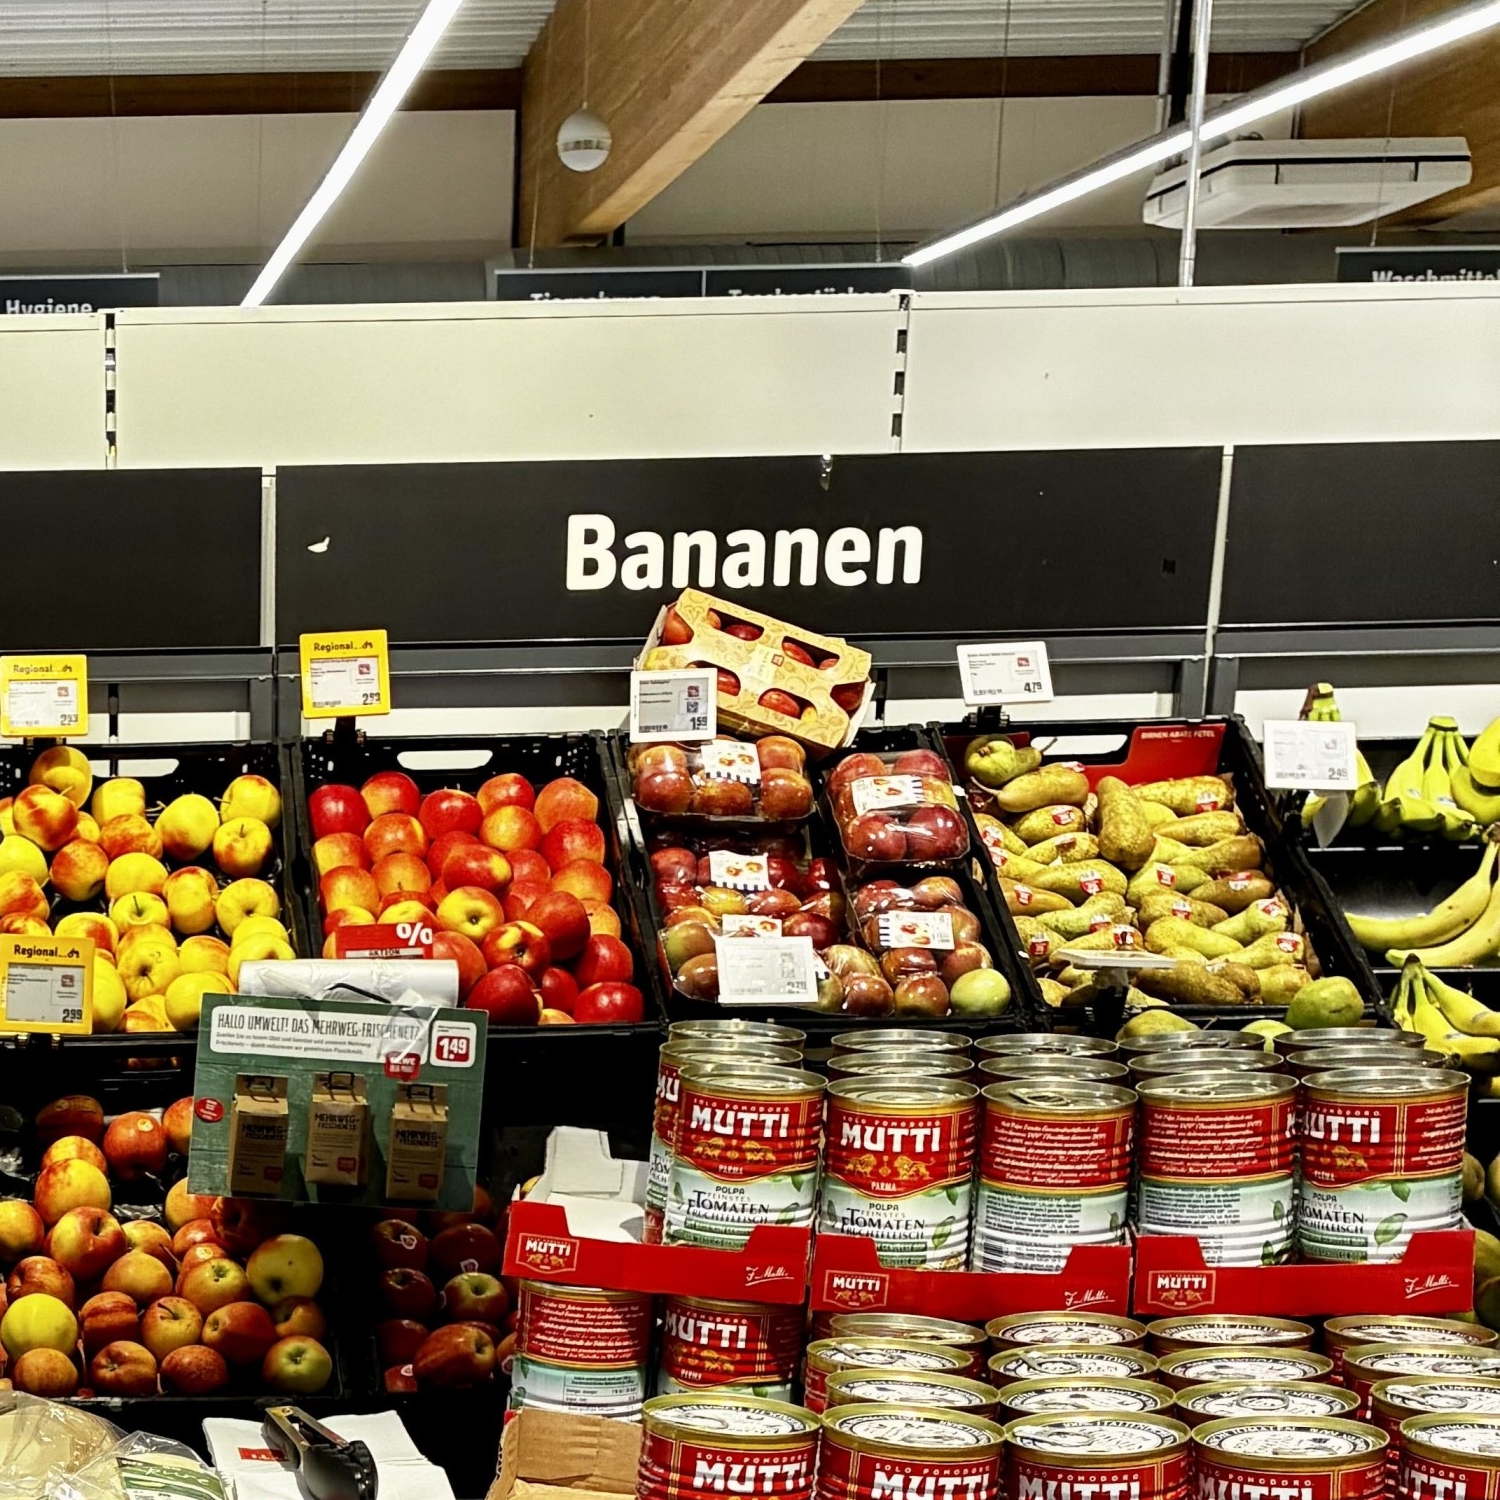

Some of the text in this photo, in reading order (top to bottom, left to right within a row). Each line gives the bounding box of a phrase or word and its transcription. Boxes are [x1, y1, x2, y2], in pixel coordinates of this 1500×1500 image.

[565, 512, 924, 591] Bananen
[313, 641, 353, 653] Regional
[13, 944, 58, 958] Regional
[217, 1013, 245, 1029] HALLO
[247, 1015, 289, 1032] UMWELT!
[291, 1018, 309, 1034] DAS
[438, 1037, 468, 1060] 1.49
[690, 1104, 790, 1138] MUTTI
[840, 1122, 941, 1153] MUTTI
[715, 1185, 745, 1195] POLPA
[693, 1189, 770, 1214] TOMATEN
[868, 1202, 899, 1212] POLPA
[846, 1207, 925, 1231] TOMATEN
[525, 1239, 571, 1257] MUTTI
[832, 1276, 881, 1291] MUTTI
[1157, 1276, 1207, 1290] MUTTI
[664, 1309, 748, 1349] MUTTI
[697, 1452, 733, 1463] SOLO
[692, 1459, 808, 1494] MUTTI
[875, 1463, 912, 1473] SOLO
